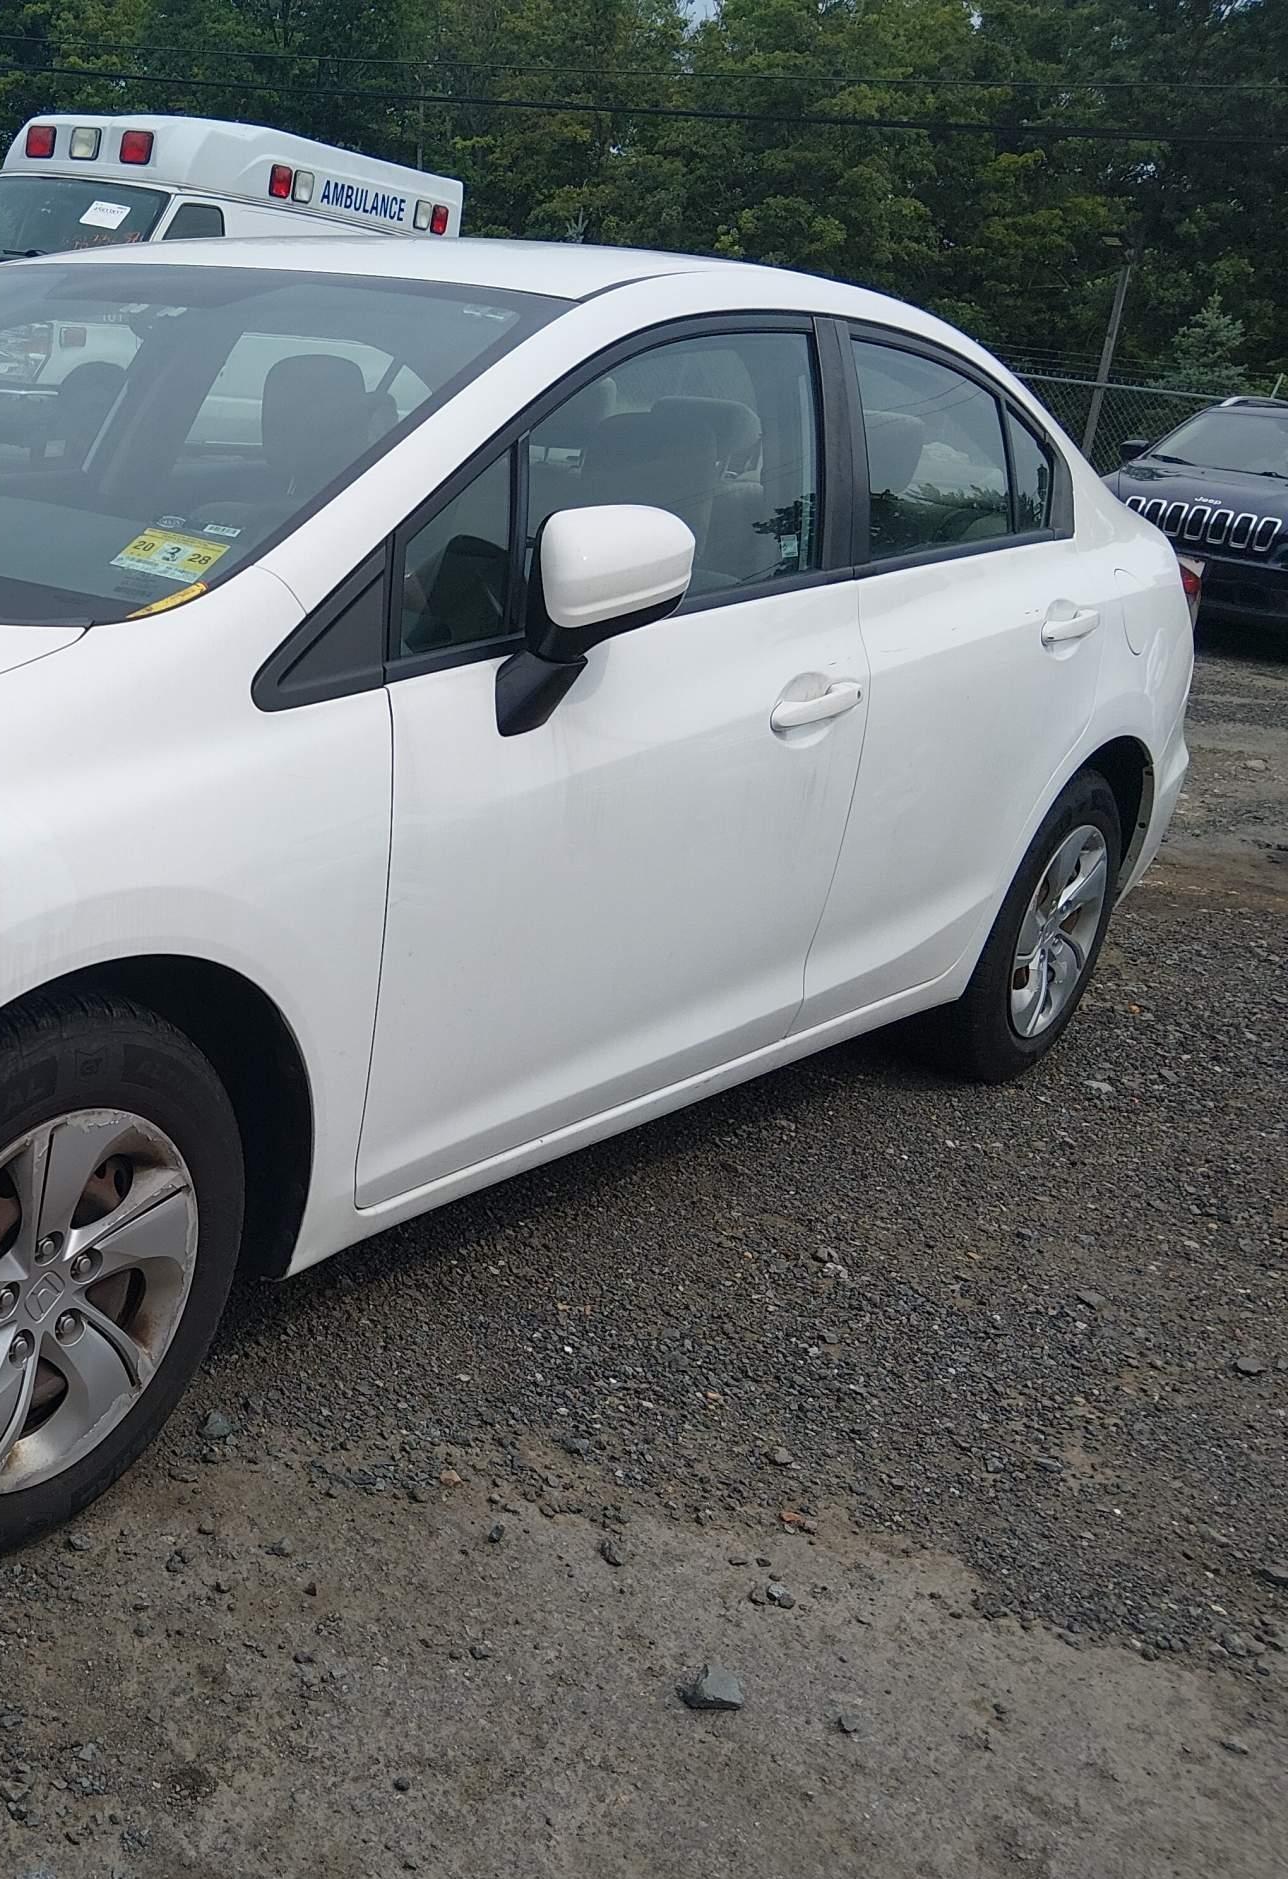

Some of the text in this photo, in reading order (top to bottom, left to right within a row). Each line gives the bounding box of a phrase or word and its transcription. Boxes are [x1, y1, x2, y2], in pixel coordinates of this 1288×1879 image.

[320, 179, 407, 222] AMBULANCE
[1194, 496, 1222, 505] Jeep
[133, 540, 155, 552] 20
[187, 553, 212, 565] 28
